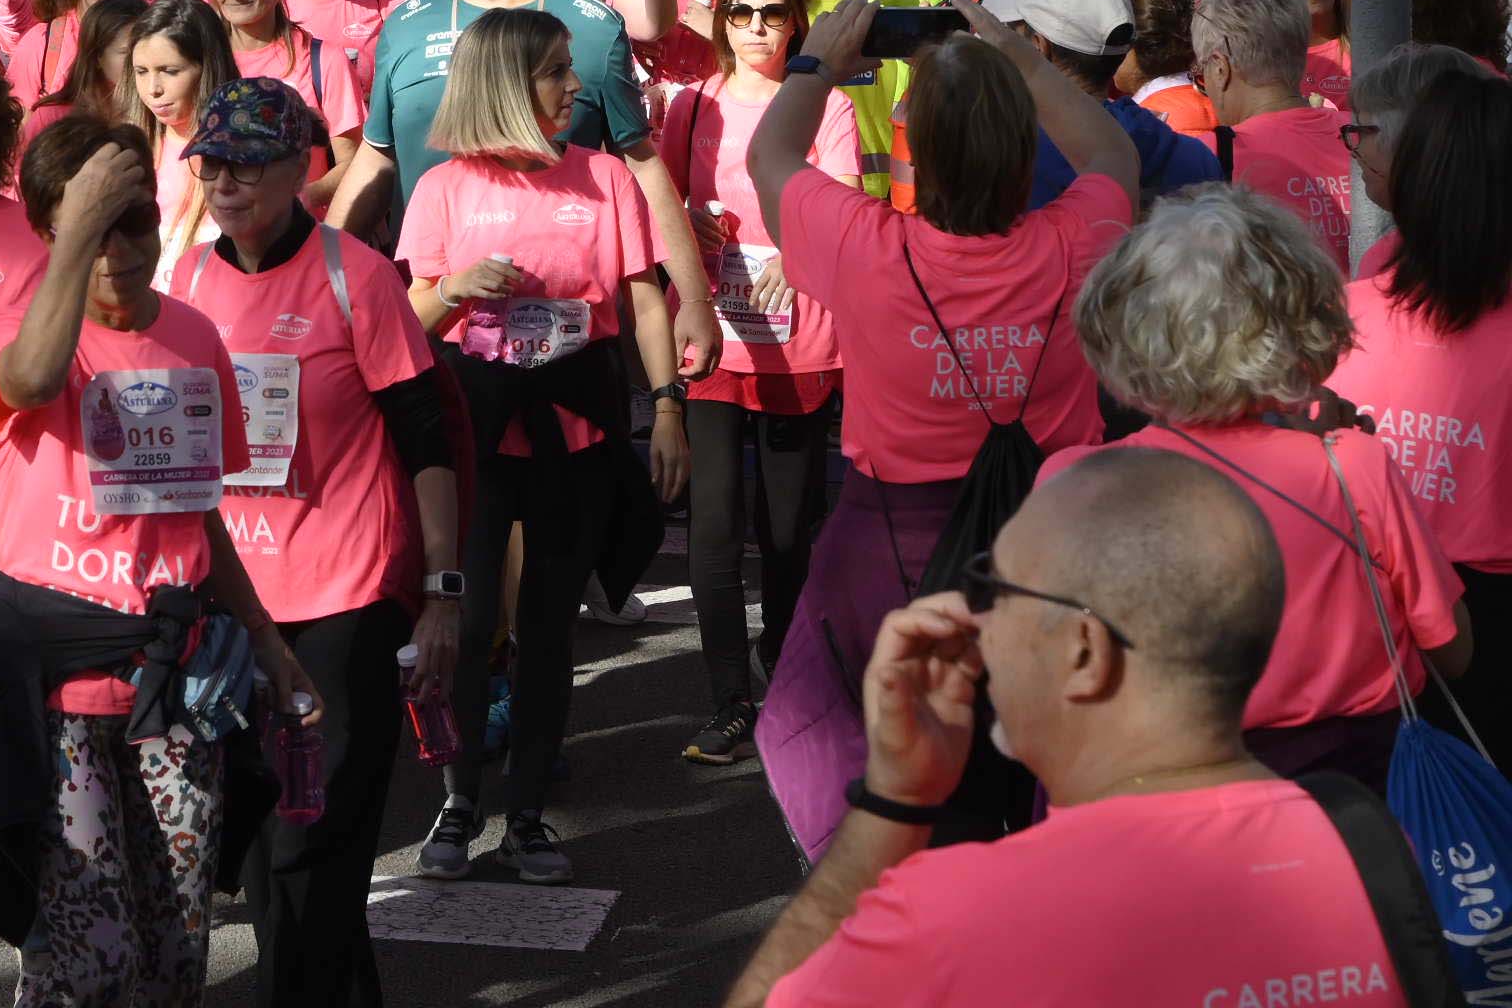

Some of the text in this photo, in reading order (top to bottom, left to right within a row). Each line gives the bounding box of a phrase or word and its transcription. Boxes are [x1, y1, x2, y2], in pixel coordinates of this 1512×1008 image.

[1309, 196, 1351, 217] DE L
[720, 281, 753, 298] 016
[512, 338, 551, 354] 016
[909, 324, 1047, 350] CARRERA
[936, 350, 1023, 375] DE LA
[930, 375, 1029, 399] MUJER
[123, 395, 172, 407] ASTURIANA
[128, 425, 175, 447] 016
[134, 453, 171, 466] 22859
[265, 448, 287, 456] 2023
[103, 474, 139, 482] CARRERA
[140, 473, 150, 481] DE
[151, 472, 161, 480] LA
[103, 492, 141, 504] OYSHO
[57, 494, 103, 533] TU
[51, 539, 191, 586] DORSAL
